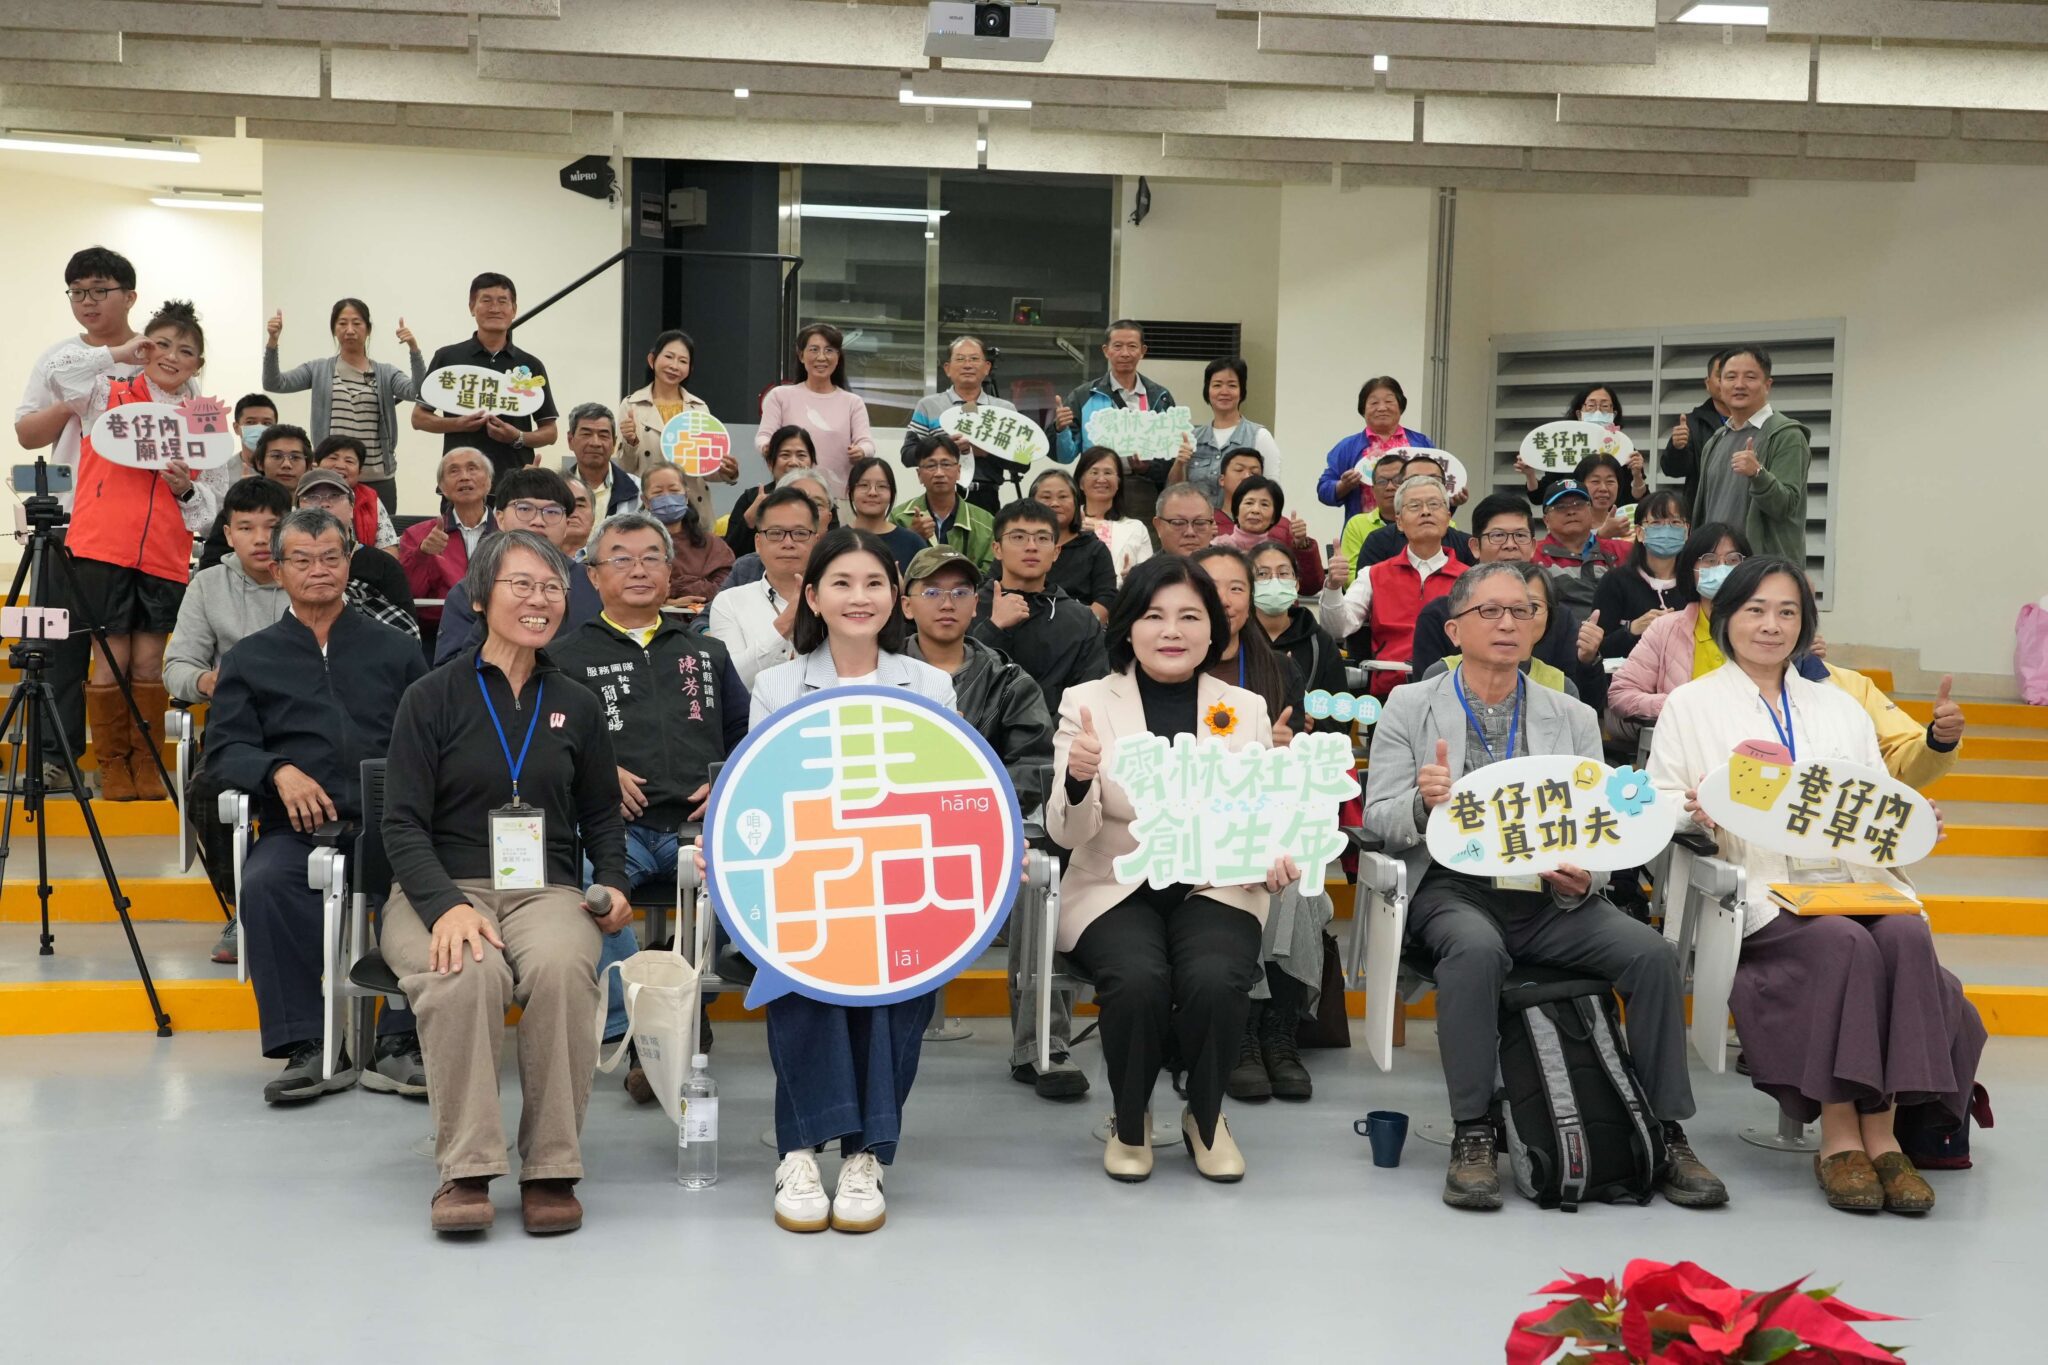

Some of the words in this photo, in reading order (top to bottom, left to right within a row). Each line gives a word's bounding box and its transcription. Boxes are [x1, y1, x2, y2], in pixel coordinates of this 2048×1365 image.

[438, 371, 499, 393] 巷仔內
[456, 389, 519, 412] 逗陣玩
[106, 413, 182, 439] 巷仔內
[981, 409, 1034, 442] 巷仔內
[134, 437, 205, 461] 廟埕口
[1532, 431, 1588, 450] 巷仔內
[586, 661, 635, 677] 服務團隊
[678, 655, 703, 721] 陳芳盈
[1311, 695, 1376, 719] 協奏曲
[550, 712, 566, 728] W
[1114, 738, 1354, 802] 雲林社造
[940, 794, 990, 812] hāng
[1210, 793, 1272, 813] 2025
[1449, 778, 1573, 832] 巷仔內
[1798, 763, 1914, 829] 巷仔內
[1499, 806, 1622, 864] 真功夫
[1786, 801, 1899, 863] 古早味
[1120, 807, 1341, 890] 創生年
[750, 904, 761, 921] á
